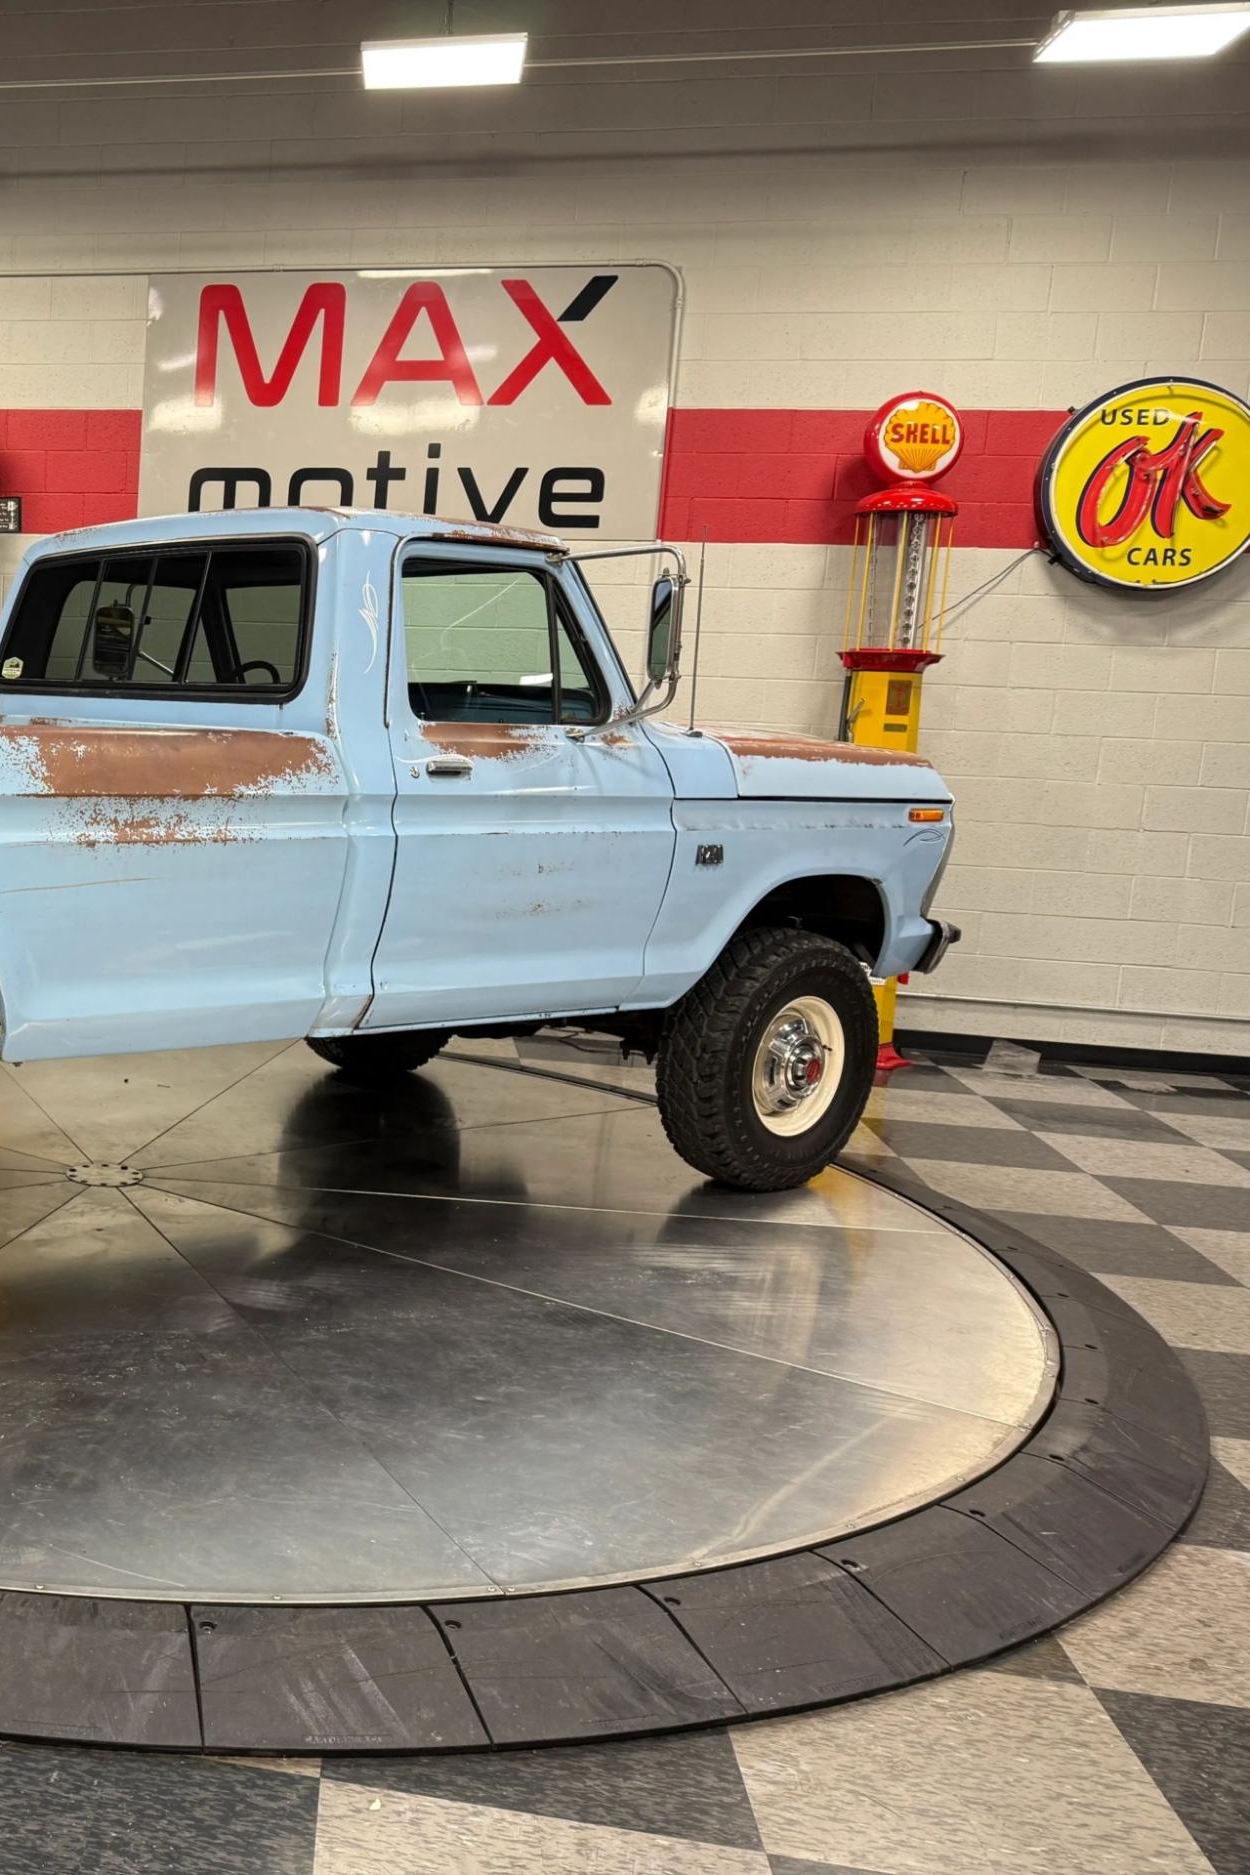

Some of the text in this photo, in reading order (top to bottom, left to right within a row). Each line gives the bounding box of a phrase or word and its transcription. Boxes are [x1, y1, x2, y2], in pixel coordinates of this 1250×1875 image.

[194, 275, 618, 407] MAX
[890, 422, 951, 445] SHELL
[1101, 408, 1170, 426] USED
[189, 443, 605, 528] motive
[1076, 411, 1231, 547] OK
[1127, 547, 1192, 566] CARS
